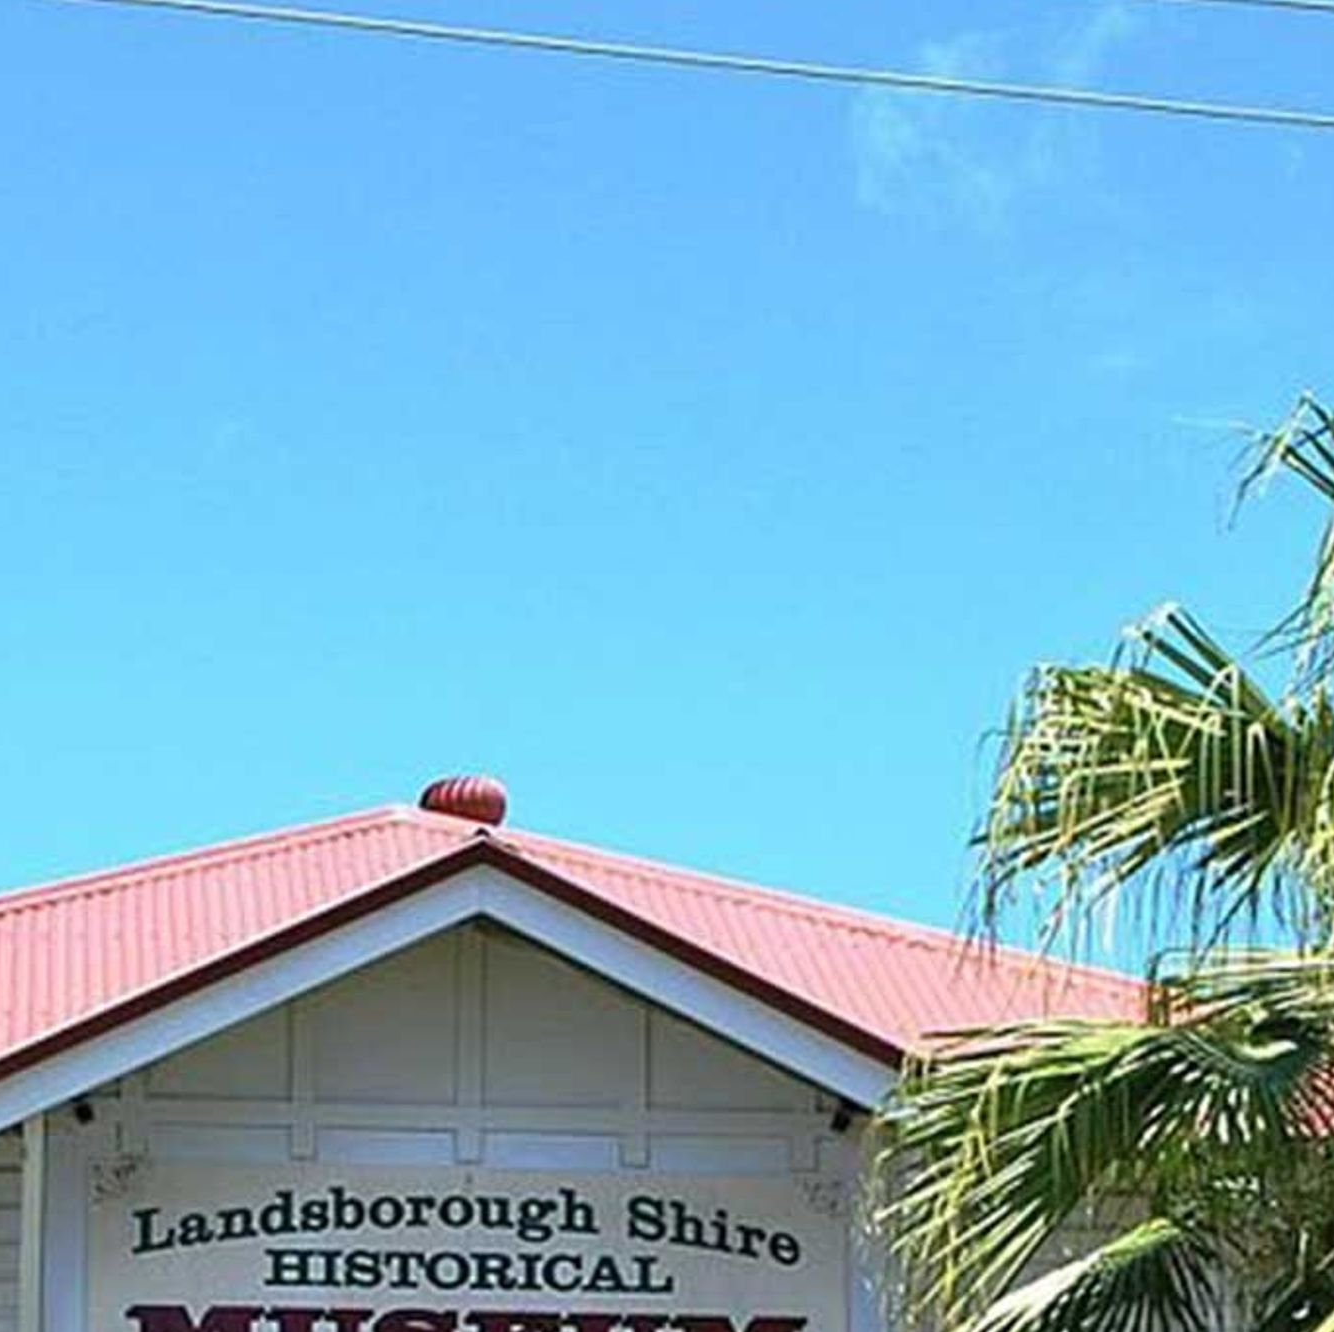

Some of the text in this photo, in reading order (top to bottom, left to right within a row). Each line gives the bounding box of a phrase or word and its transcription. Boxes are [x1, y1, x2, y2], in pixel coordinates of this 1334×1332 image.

[131, 1187, 803, 1267] Landsborough Shire
[264, 1248, 673, 1294] HISTORICAL
